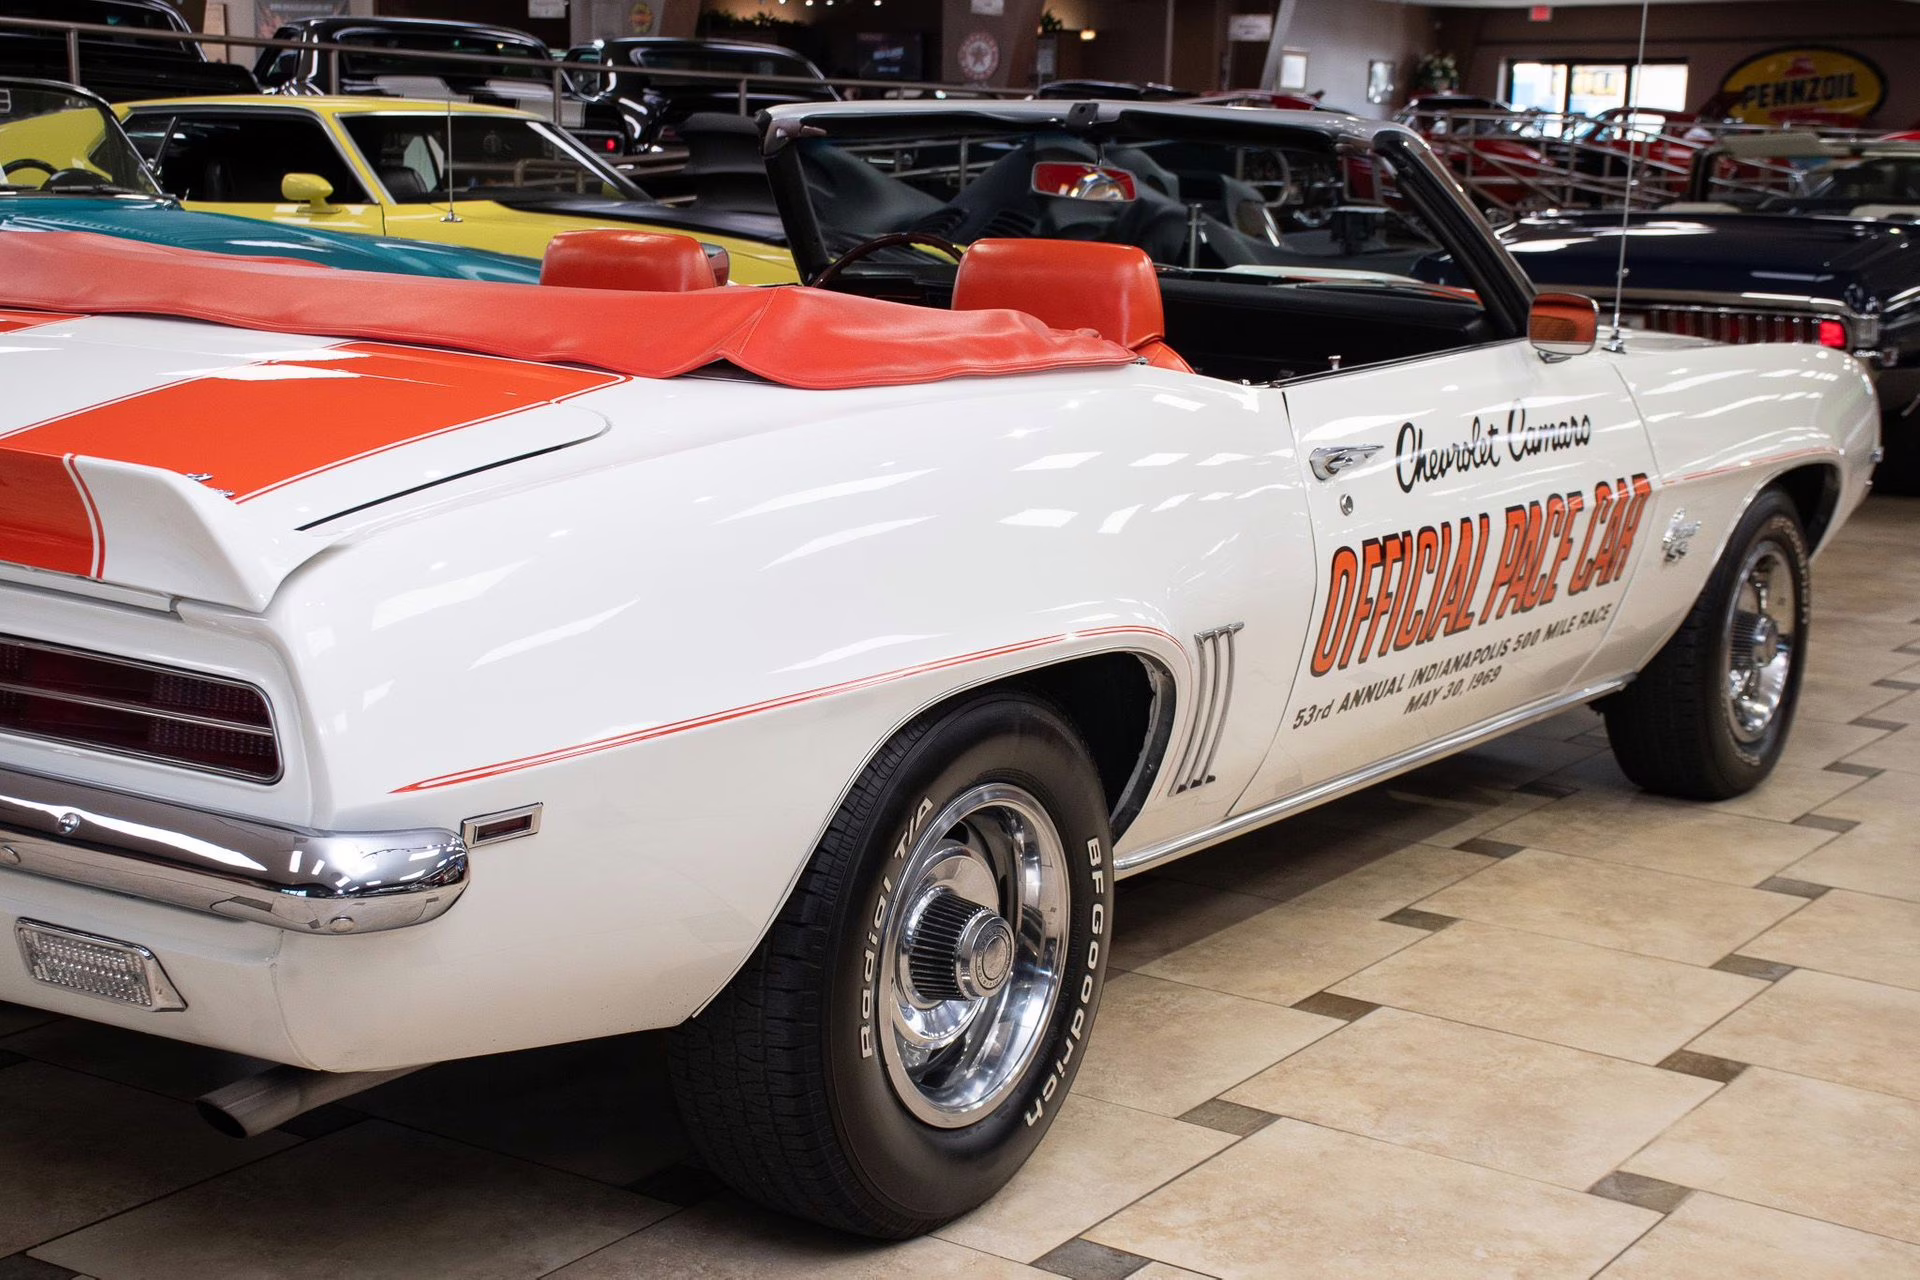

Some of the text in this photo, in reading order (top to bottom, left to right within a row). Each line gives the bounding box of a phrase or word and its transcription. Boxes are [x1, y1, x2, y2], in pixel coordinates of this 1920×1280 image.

[1741, 72, 1858, 110] PENNZOIL
[1396, 398, 1591, 493] Chevrolet Camaro
[1310, 513, 1490, 677] OFFICIAL
[1478, 491, 1584, 625] PACE
[1568, 472, 1653, 597] CAR
[1292, 603, 1612, 730] 53rd ANNUAL INDIANAPOLIS 500 MILE RACE
[1403, 665, 1502, 715] MAY 30, 1969
[860, 797, 934, 1058] Radial T/A
